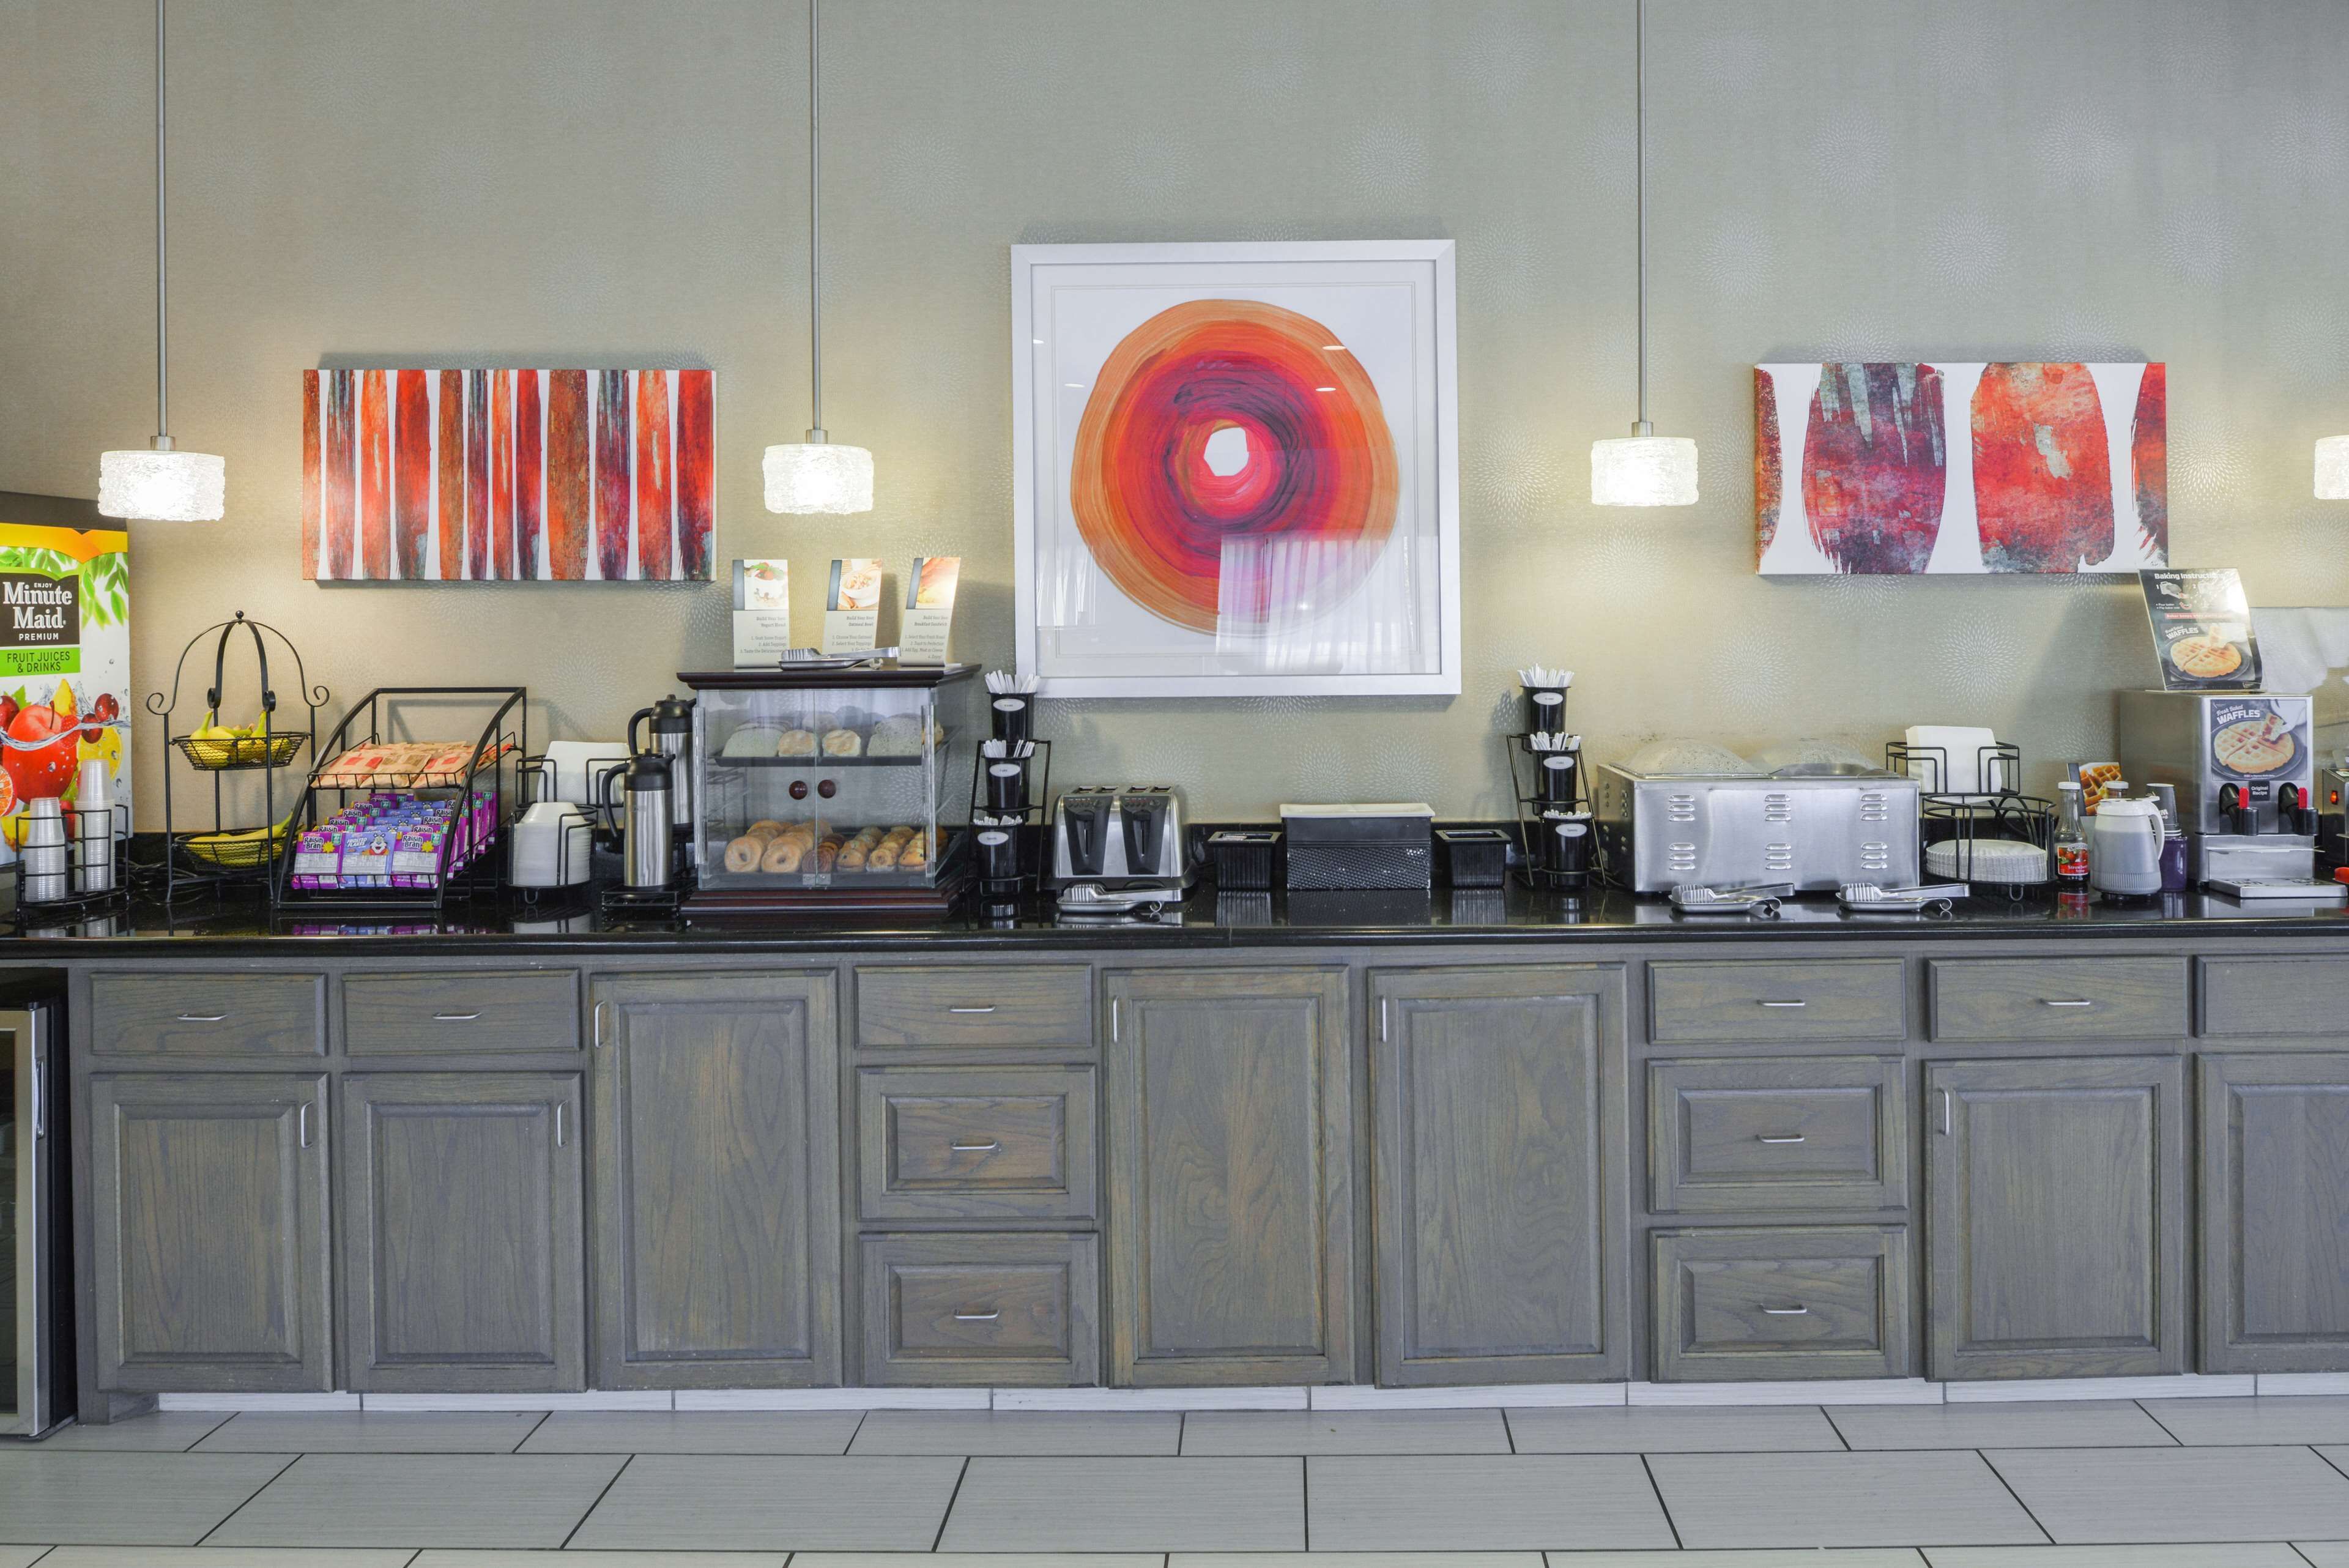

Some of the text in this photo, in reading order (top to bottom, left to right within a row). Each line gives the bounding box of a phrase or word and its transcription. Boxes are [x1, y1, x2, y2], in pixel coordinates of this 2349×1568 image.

[2, 581, 72, 605] Minute
[13, 606, 64, 629] Maid
[2166, 628, 2199, 639] WAFFLES
[7, 651, 70, 663] FRUIT JUICES
[17, 661, 61, 673] & DRINKS
[2216, 710, 2261, 725] WAFFLES
